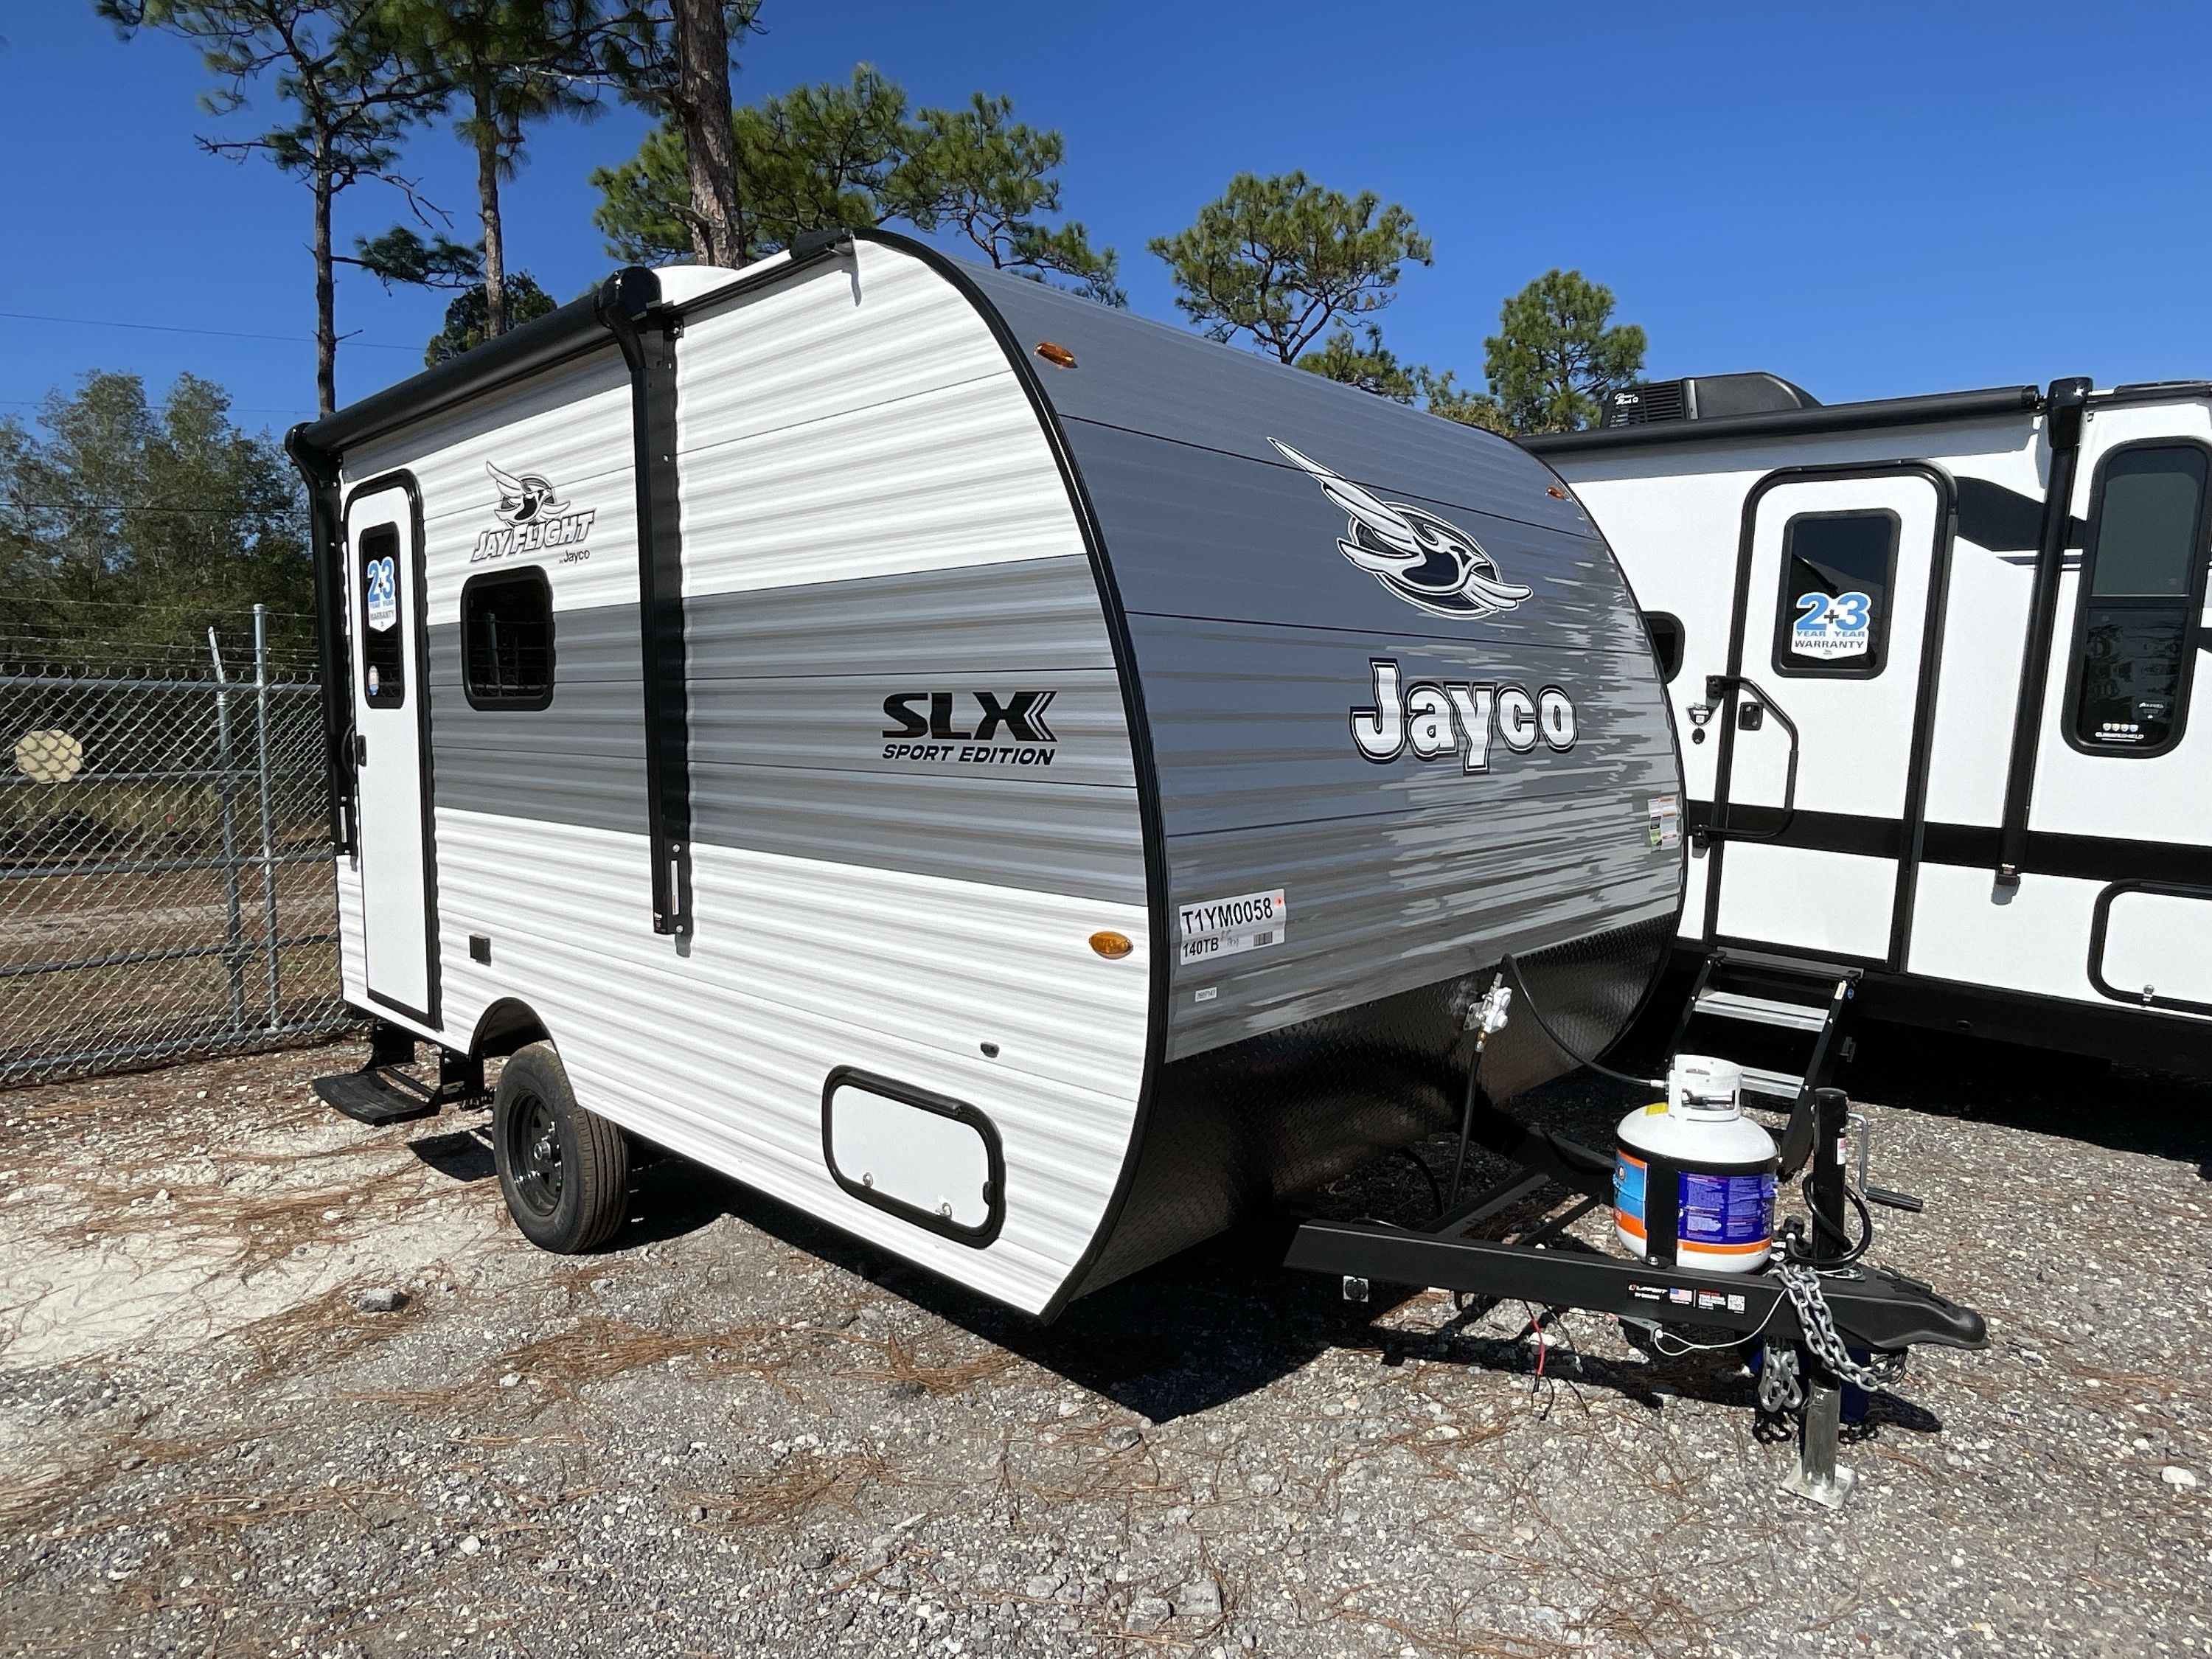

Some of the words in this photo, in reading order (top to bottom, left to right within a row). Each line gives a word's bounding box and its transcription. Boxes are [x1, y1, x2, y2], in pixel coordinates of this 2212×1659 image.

[470, 528, 512, 563] JAY
[509, 509, 597, 554] FLIGHT
[563, 549, 591, 563] Jayco
[1795, 640, 1865, 649] WARRANTY
[883, 691, 1057, 742] SLX
[1349, 658, 1578, 774] Jayco
[883, 744, 954, 761] SPORT
[959, 746, 1055, 765] EDITION
[1182, 897, 1273, 934] T1YM0058
[1183, 937, 1219, 958] 140TB
